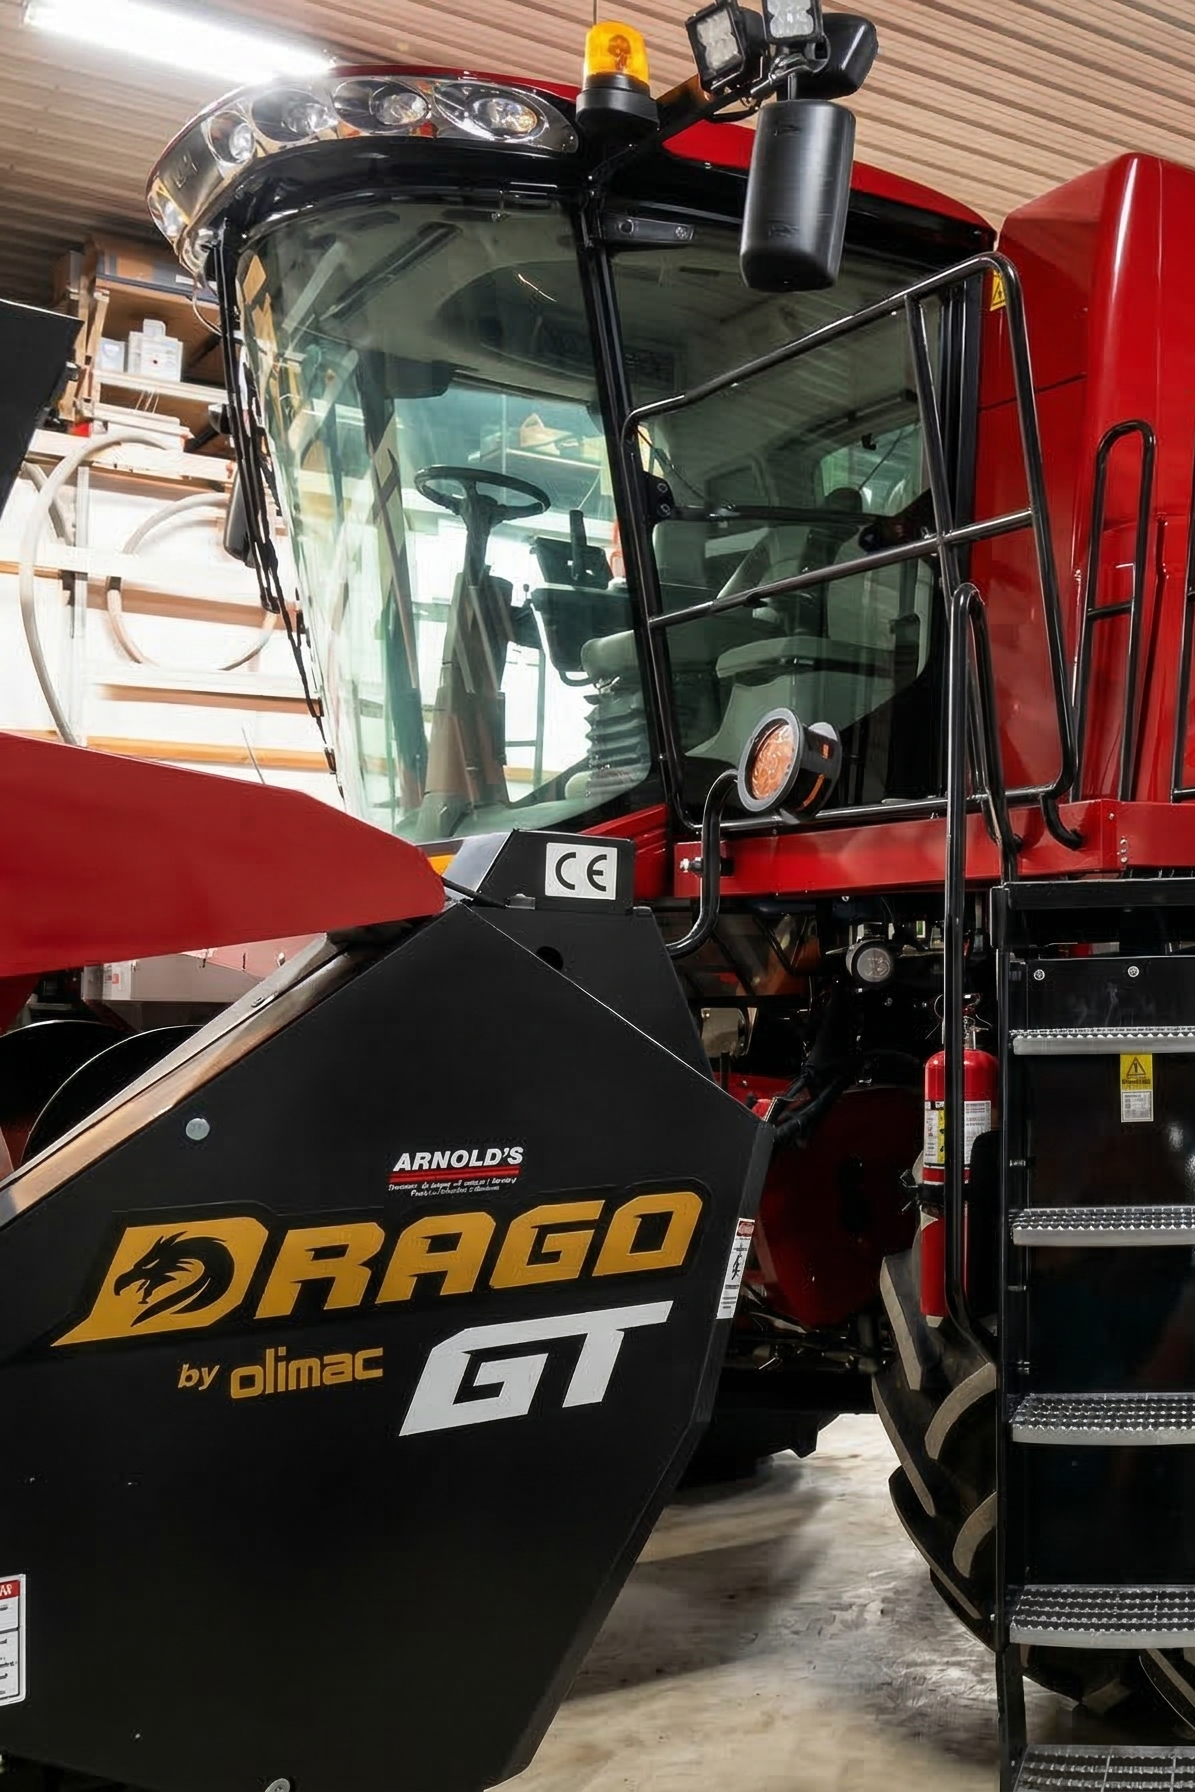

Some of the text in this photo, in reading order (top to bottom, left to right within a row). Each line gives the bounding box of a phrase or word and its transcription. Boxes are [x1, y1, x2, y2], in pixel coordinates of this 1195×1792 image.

[392, 1146, 524, 1172] ARNOLD'S
[51, 1191, 703, 1347] DRAGO
[178, 1346, 383, 1399] by olimac
[399, 1300, 674, 1437] GT
